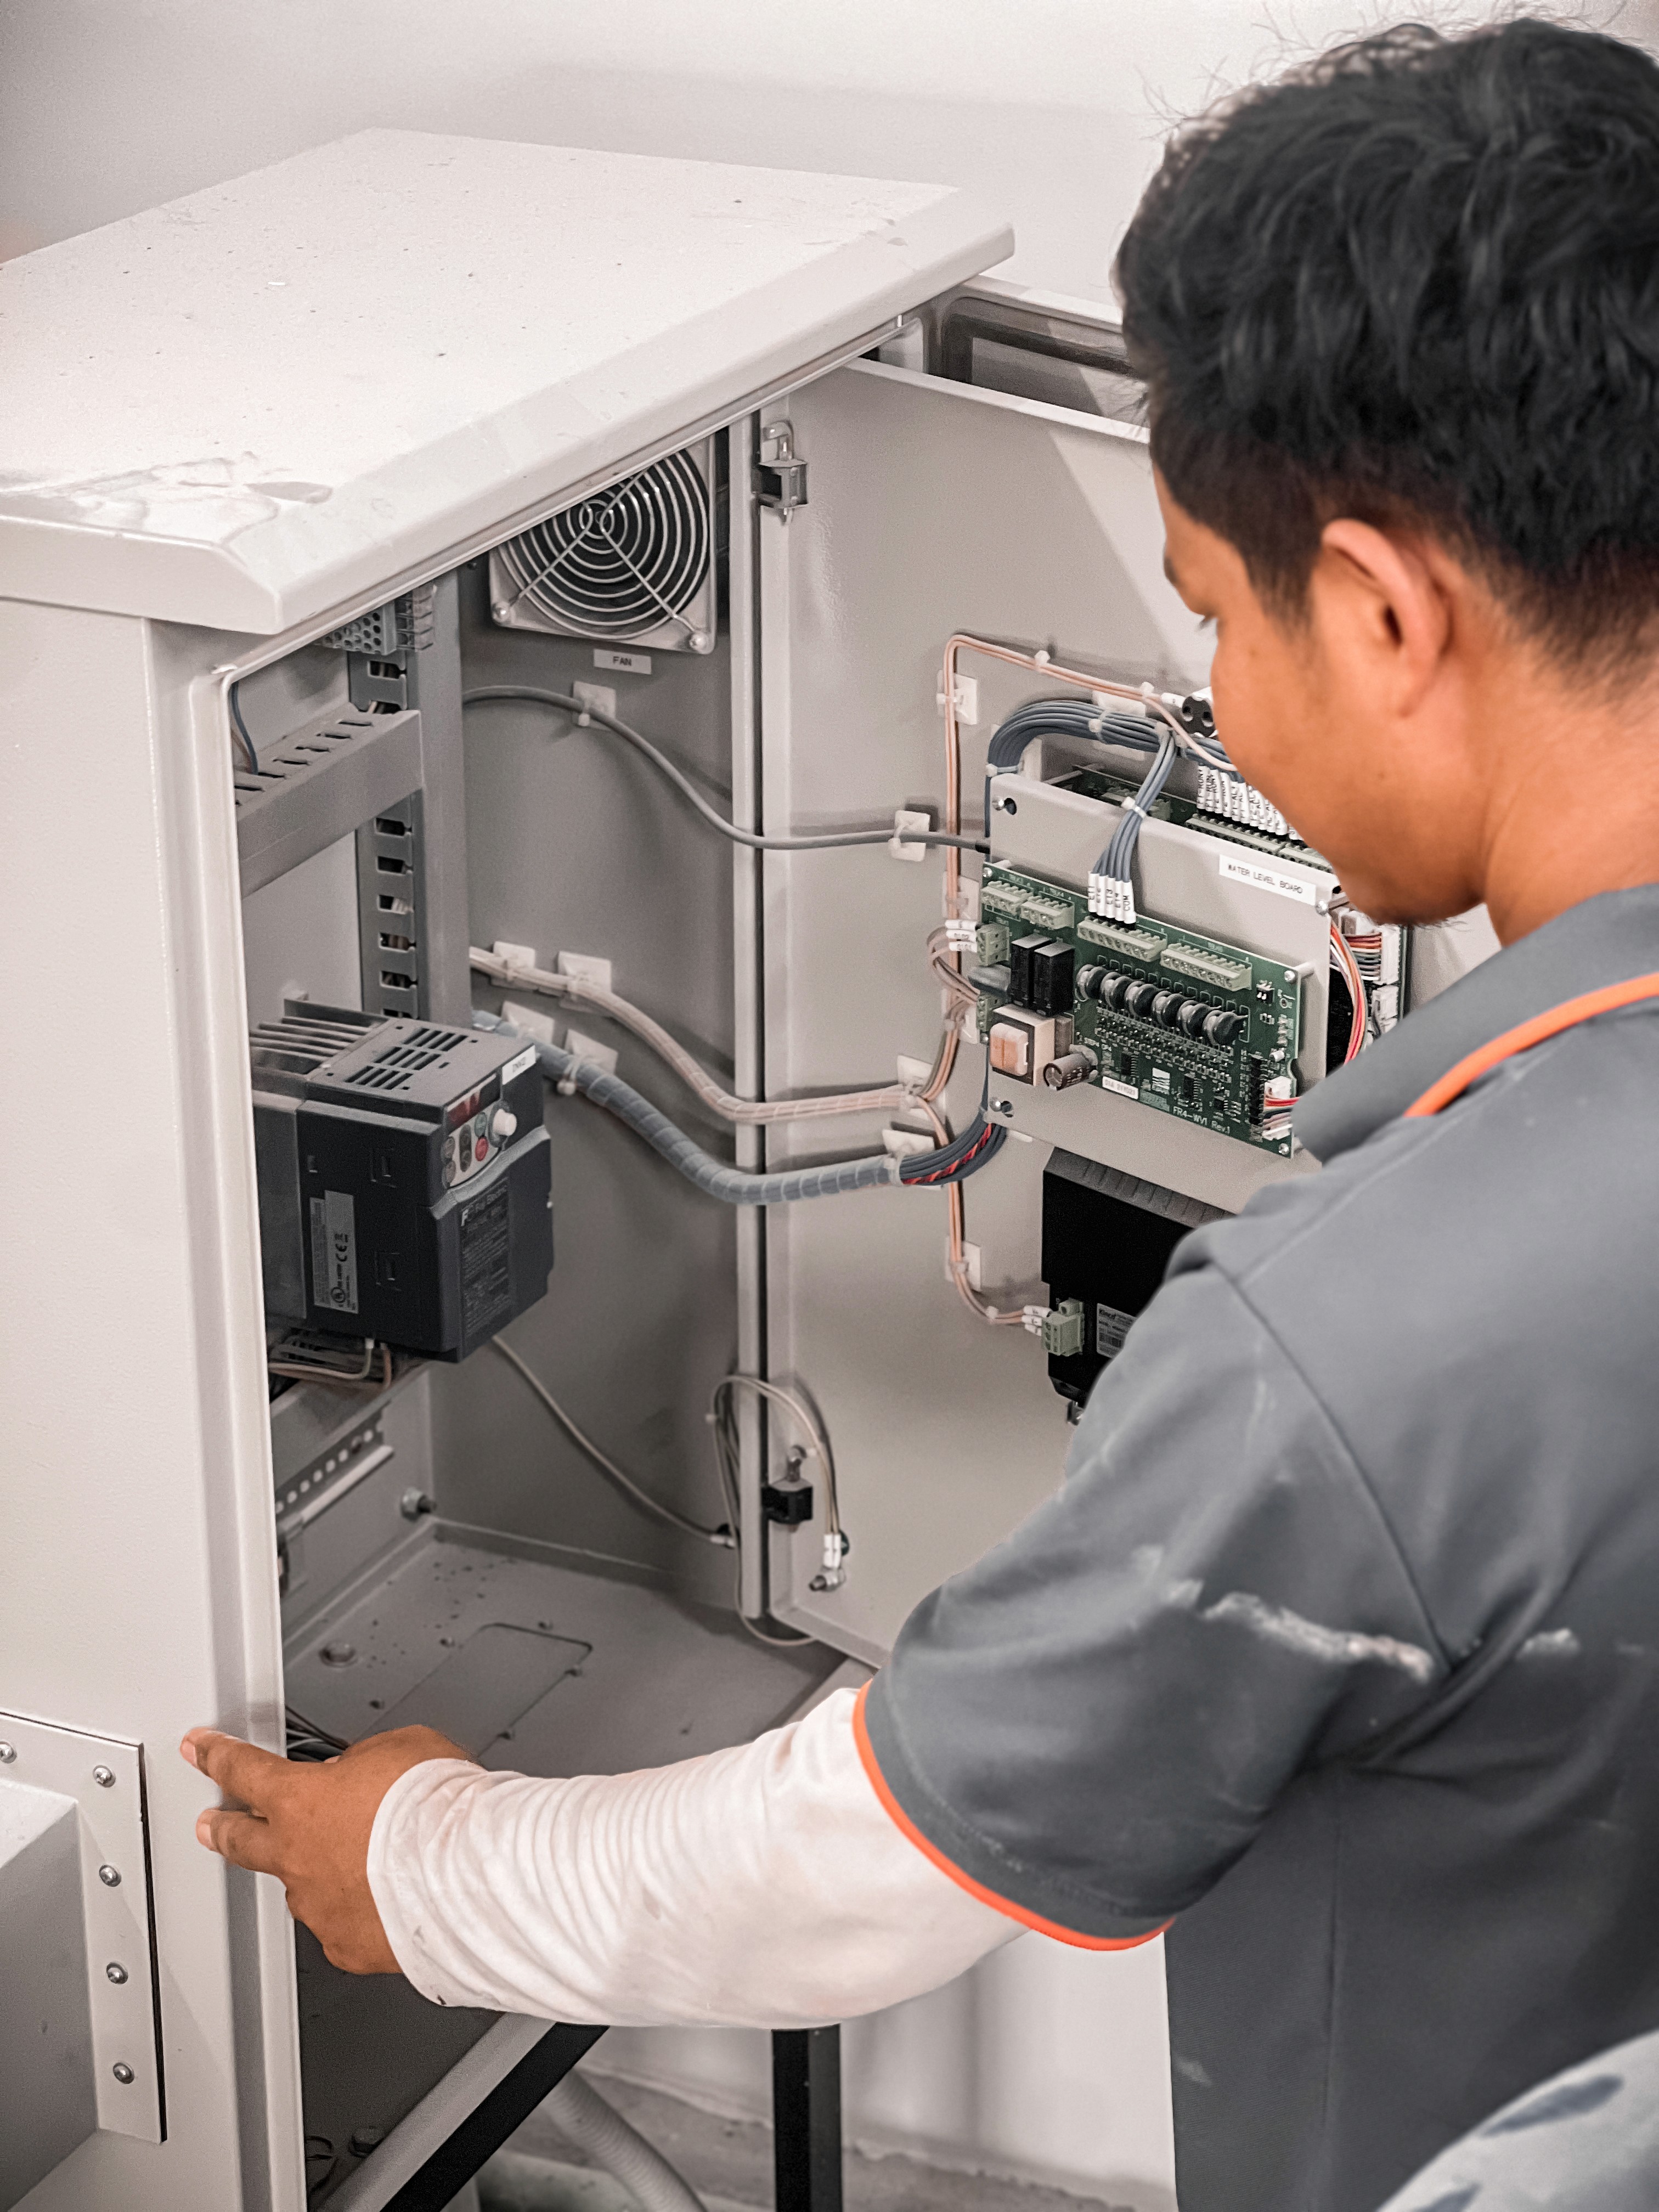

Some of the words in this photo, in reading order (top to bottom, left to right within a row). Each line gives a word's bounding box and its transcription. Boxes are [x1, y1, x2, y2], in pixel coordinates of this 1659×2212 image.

[613, 656, 632, 667] FAN
[1228, 864, 1250, 877] WATER
[1253, 871, 1276, 885] LEVEL
[1279, 880, 1304, 894] BOARD
[1122, 895, 1131, 911] COM
